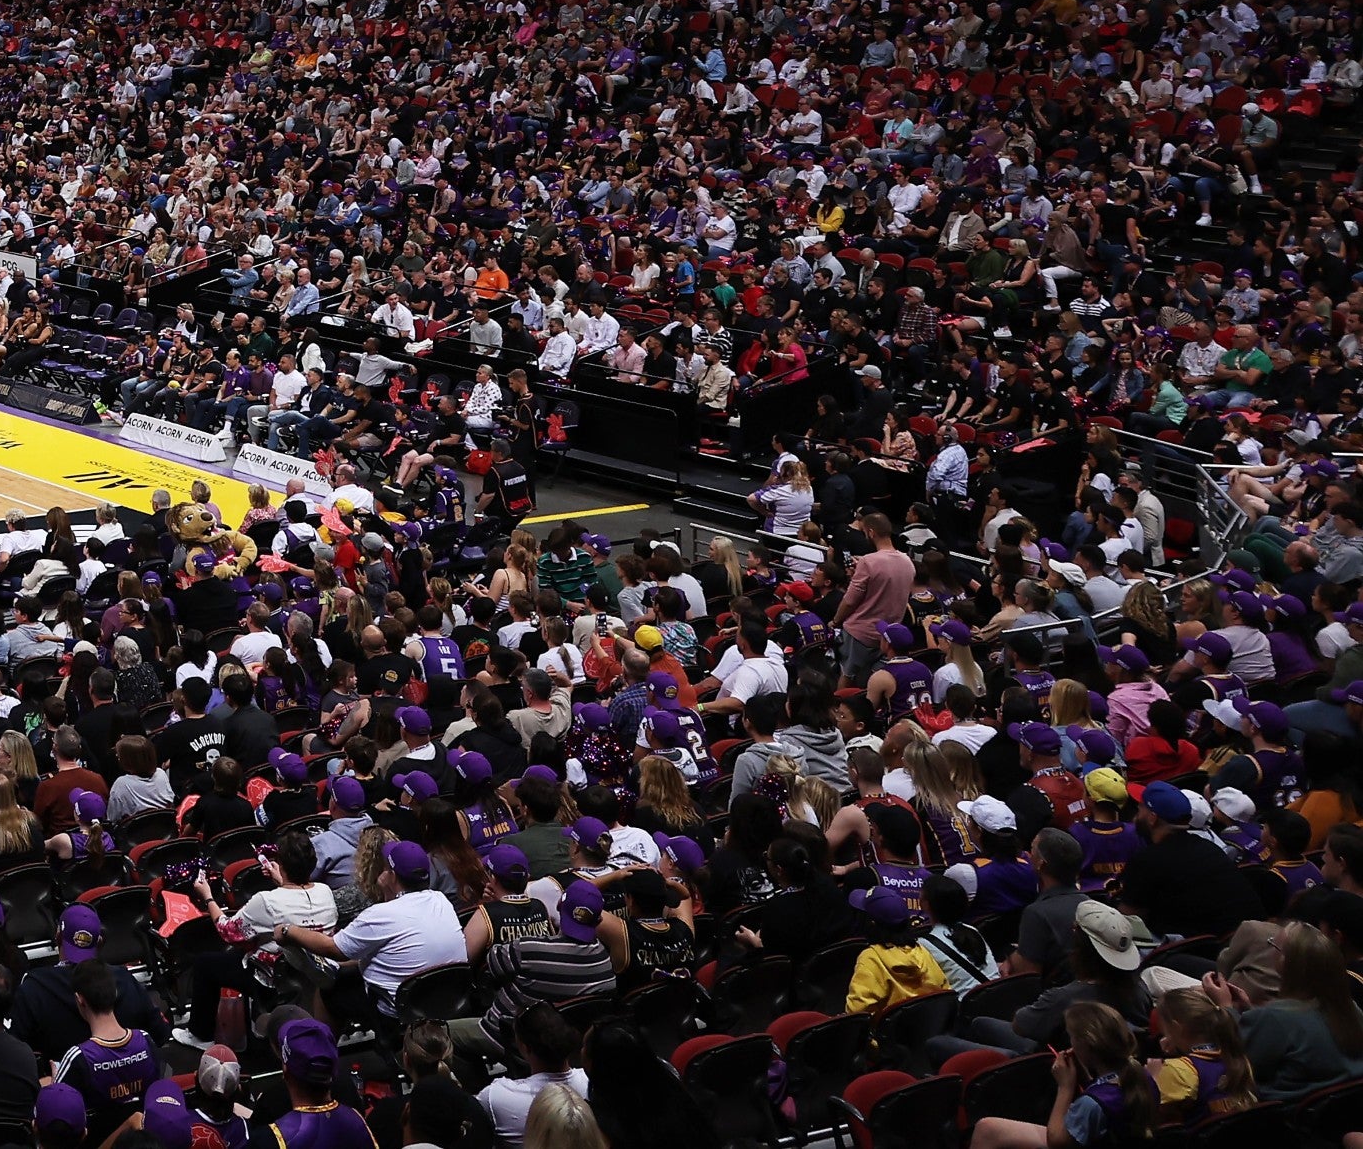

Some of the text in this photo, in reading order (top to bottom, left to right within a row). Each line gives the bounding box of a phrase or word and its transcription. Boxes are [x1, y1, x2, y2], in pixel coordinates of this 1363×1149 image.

[126, 417, 213, 448] ACORN ACORN ACORN
[239, 450, 300, 475] ACORN ACORN
[439, 657, 458, 680] 5
[882, 875, 918, 888] Beyond
[93, 1050, 148, 1071] POWERADE
[110, 1079, 143, 1100] BOGUT
